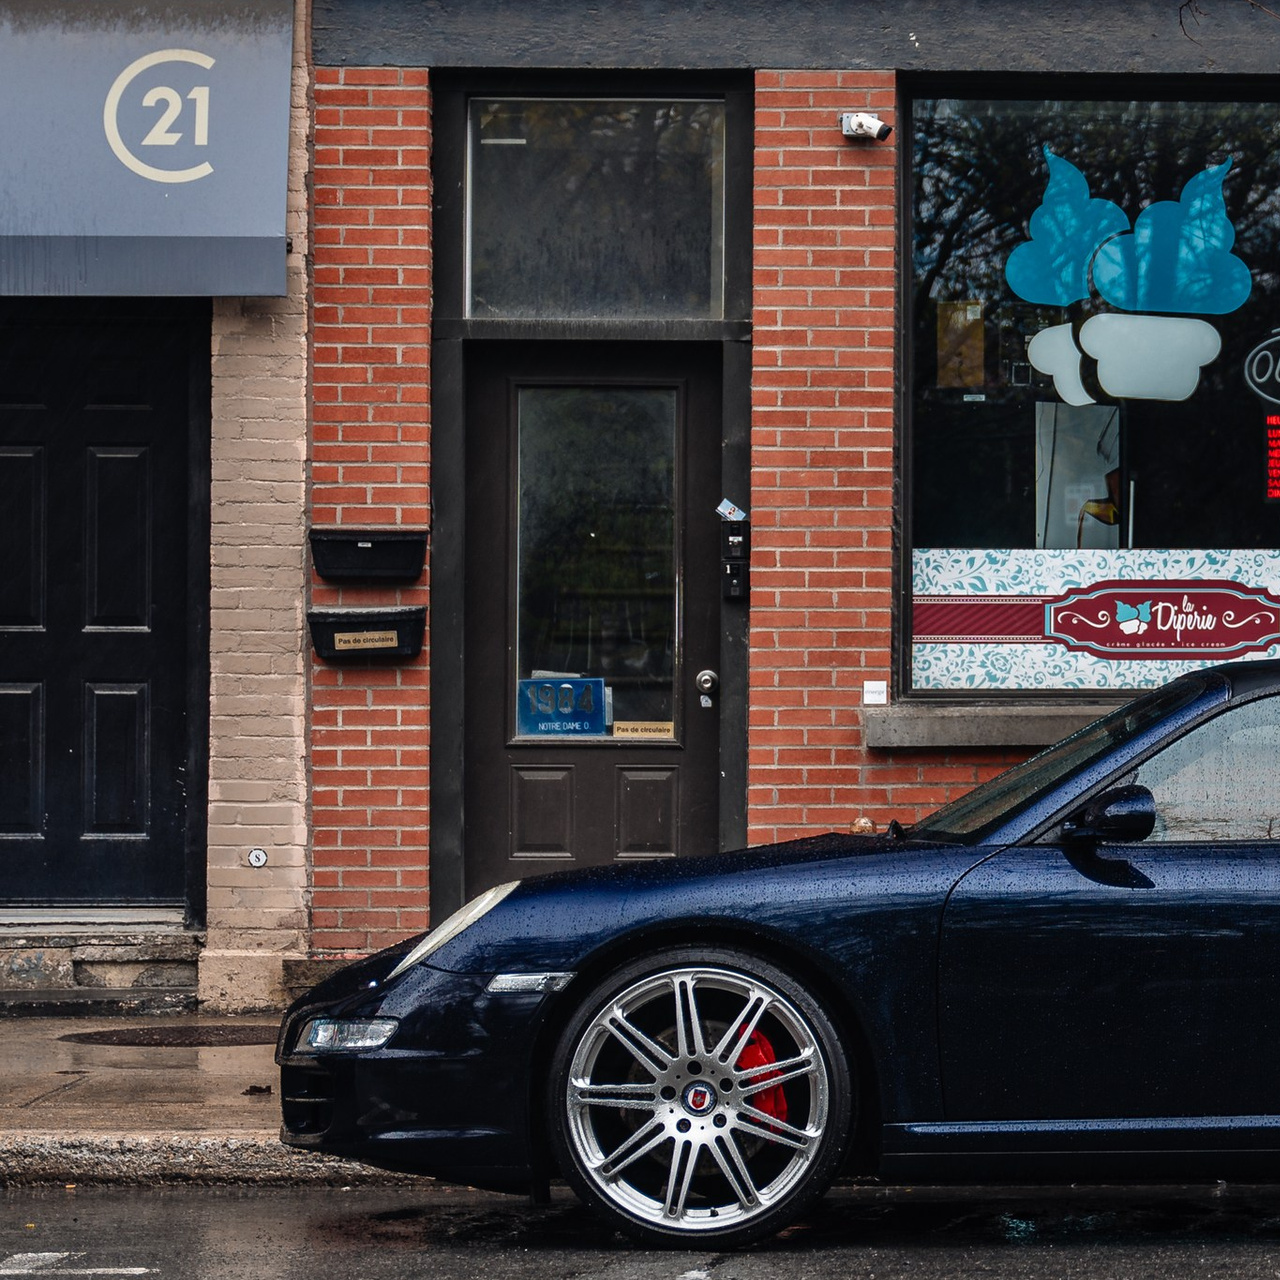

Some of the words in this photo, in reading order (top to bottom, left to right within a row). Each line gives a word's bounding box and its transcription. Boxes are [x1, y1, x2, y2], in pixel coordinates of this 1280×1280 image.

[1267, 459, 1280, 468] JEU
[1182, 594, 1195, 613] la
[1152, 602, 1217, 642] Diperie
[362, 636, 394, 644] circulaire
[528, 683, 595, 715] 1984
[538, 721, 561, 731] NOTRE
[562, 721, 582, 731] DAME
[631, 725, 639, 733] de
[640, 725, 671, 734] circulaire
